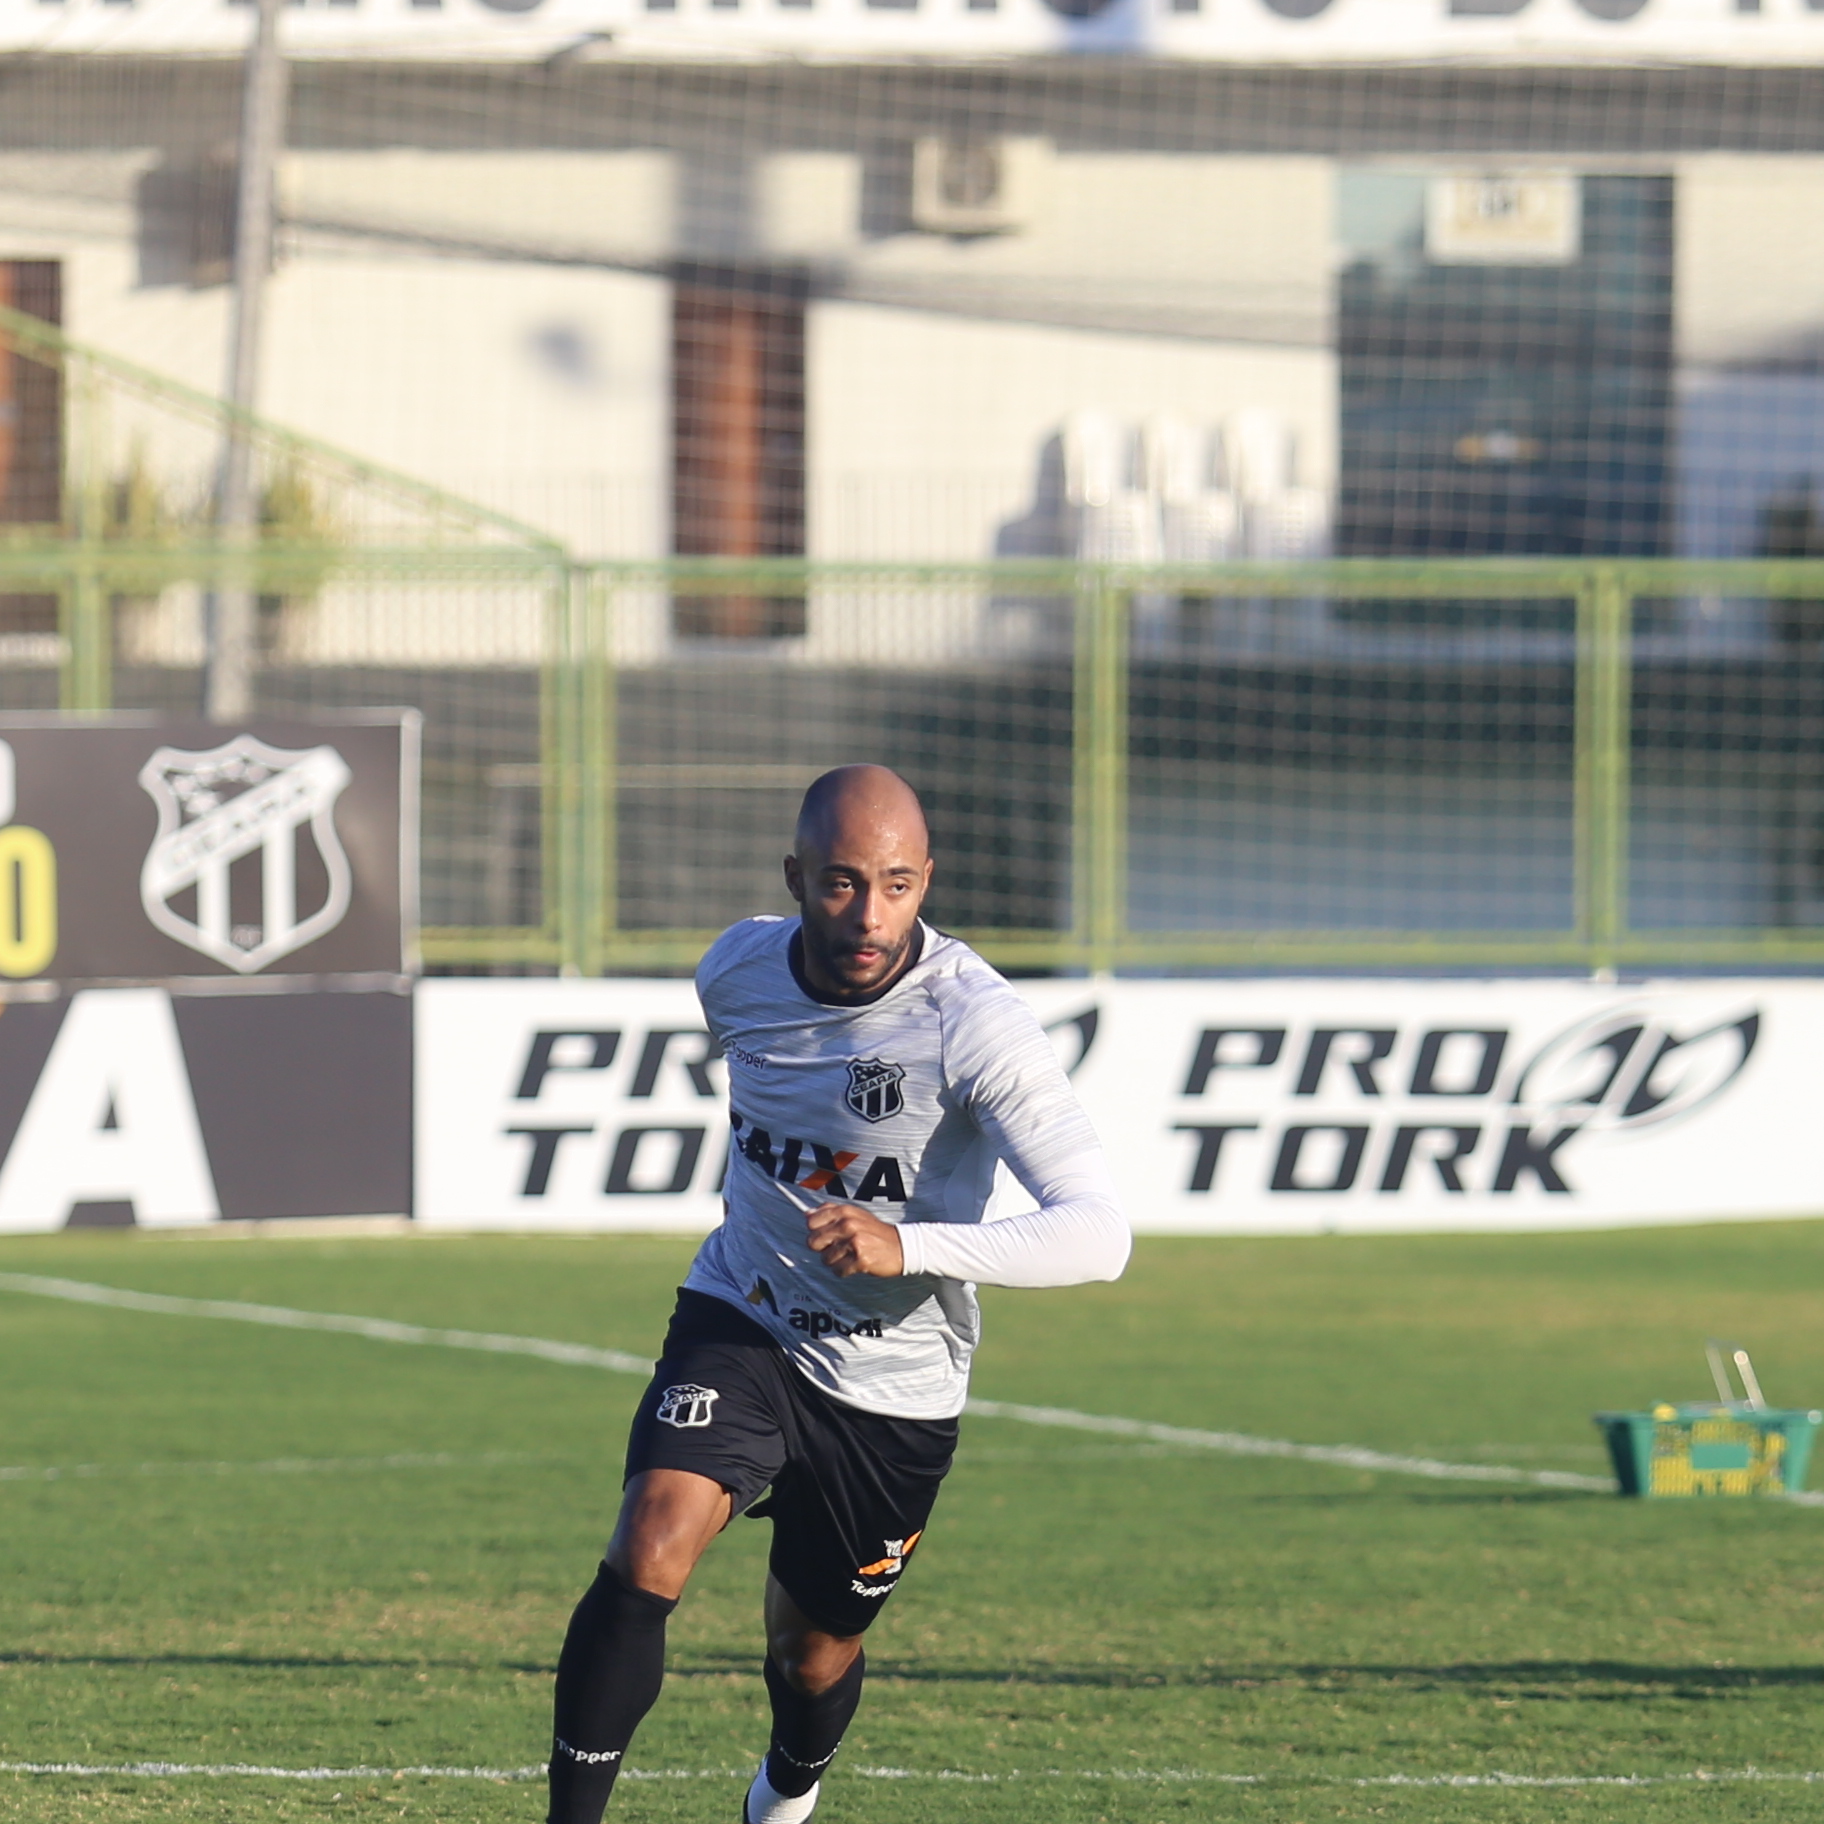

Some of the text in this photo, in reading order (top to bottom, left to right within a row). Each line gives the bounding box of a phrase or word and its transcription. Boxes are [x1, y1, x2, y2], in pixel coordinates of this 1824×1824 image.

[515, 1030, 726, 1098] PR
[1181, 1028, 1509, 1096] PRO
[504, 1126, 728, 1196] TO
[1171, 1124, 1578, 1193] TORK
